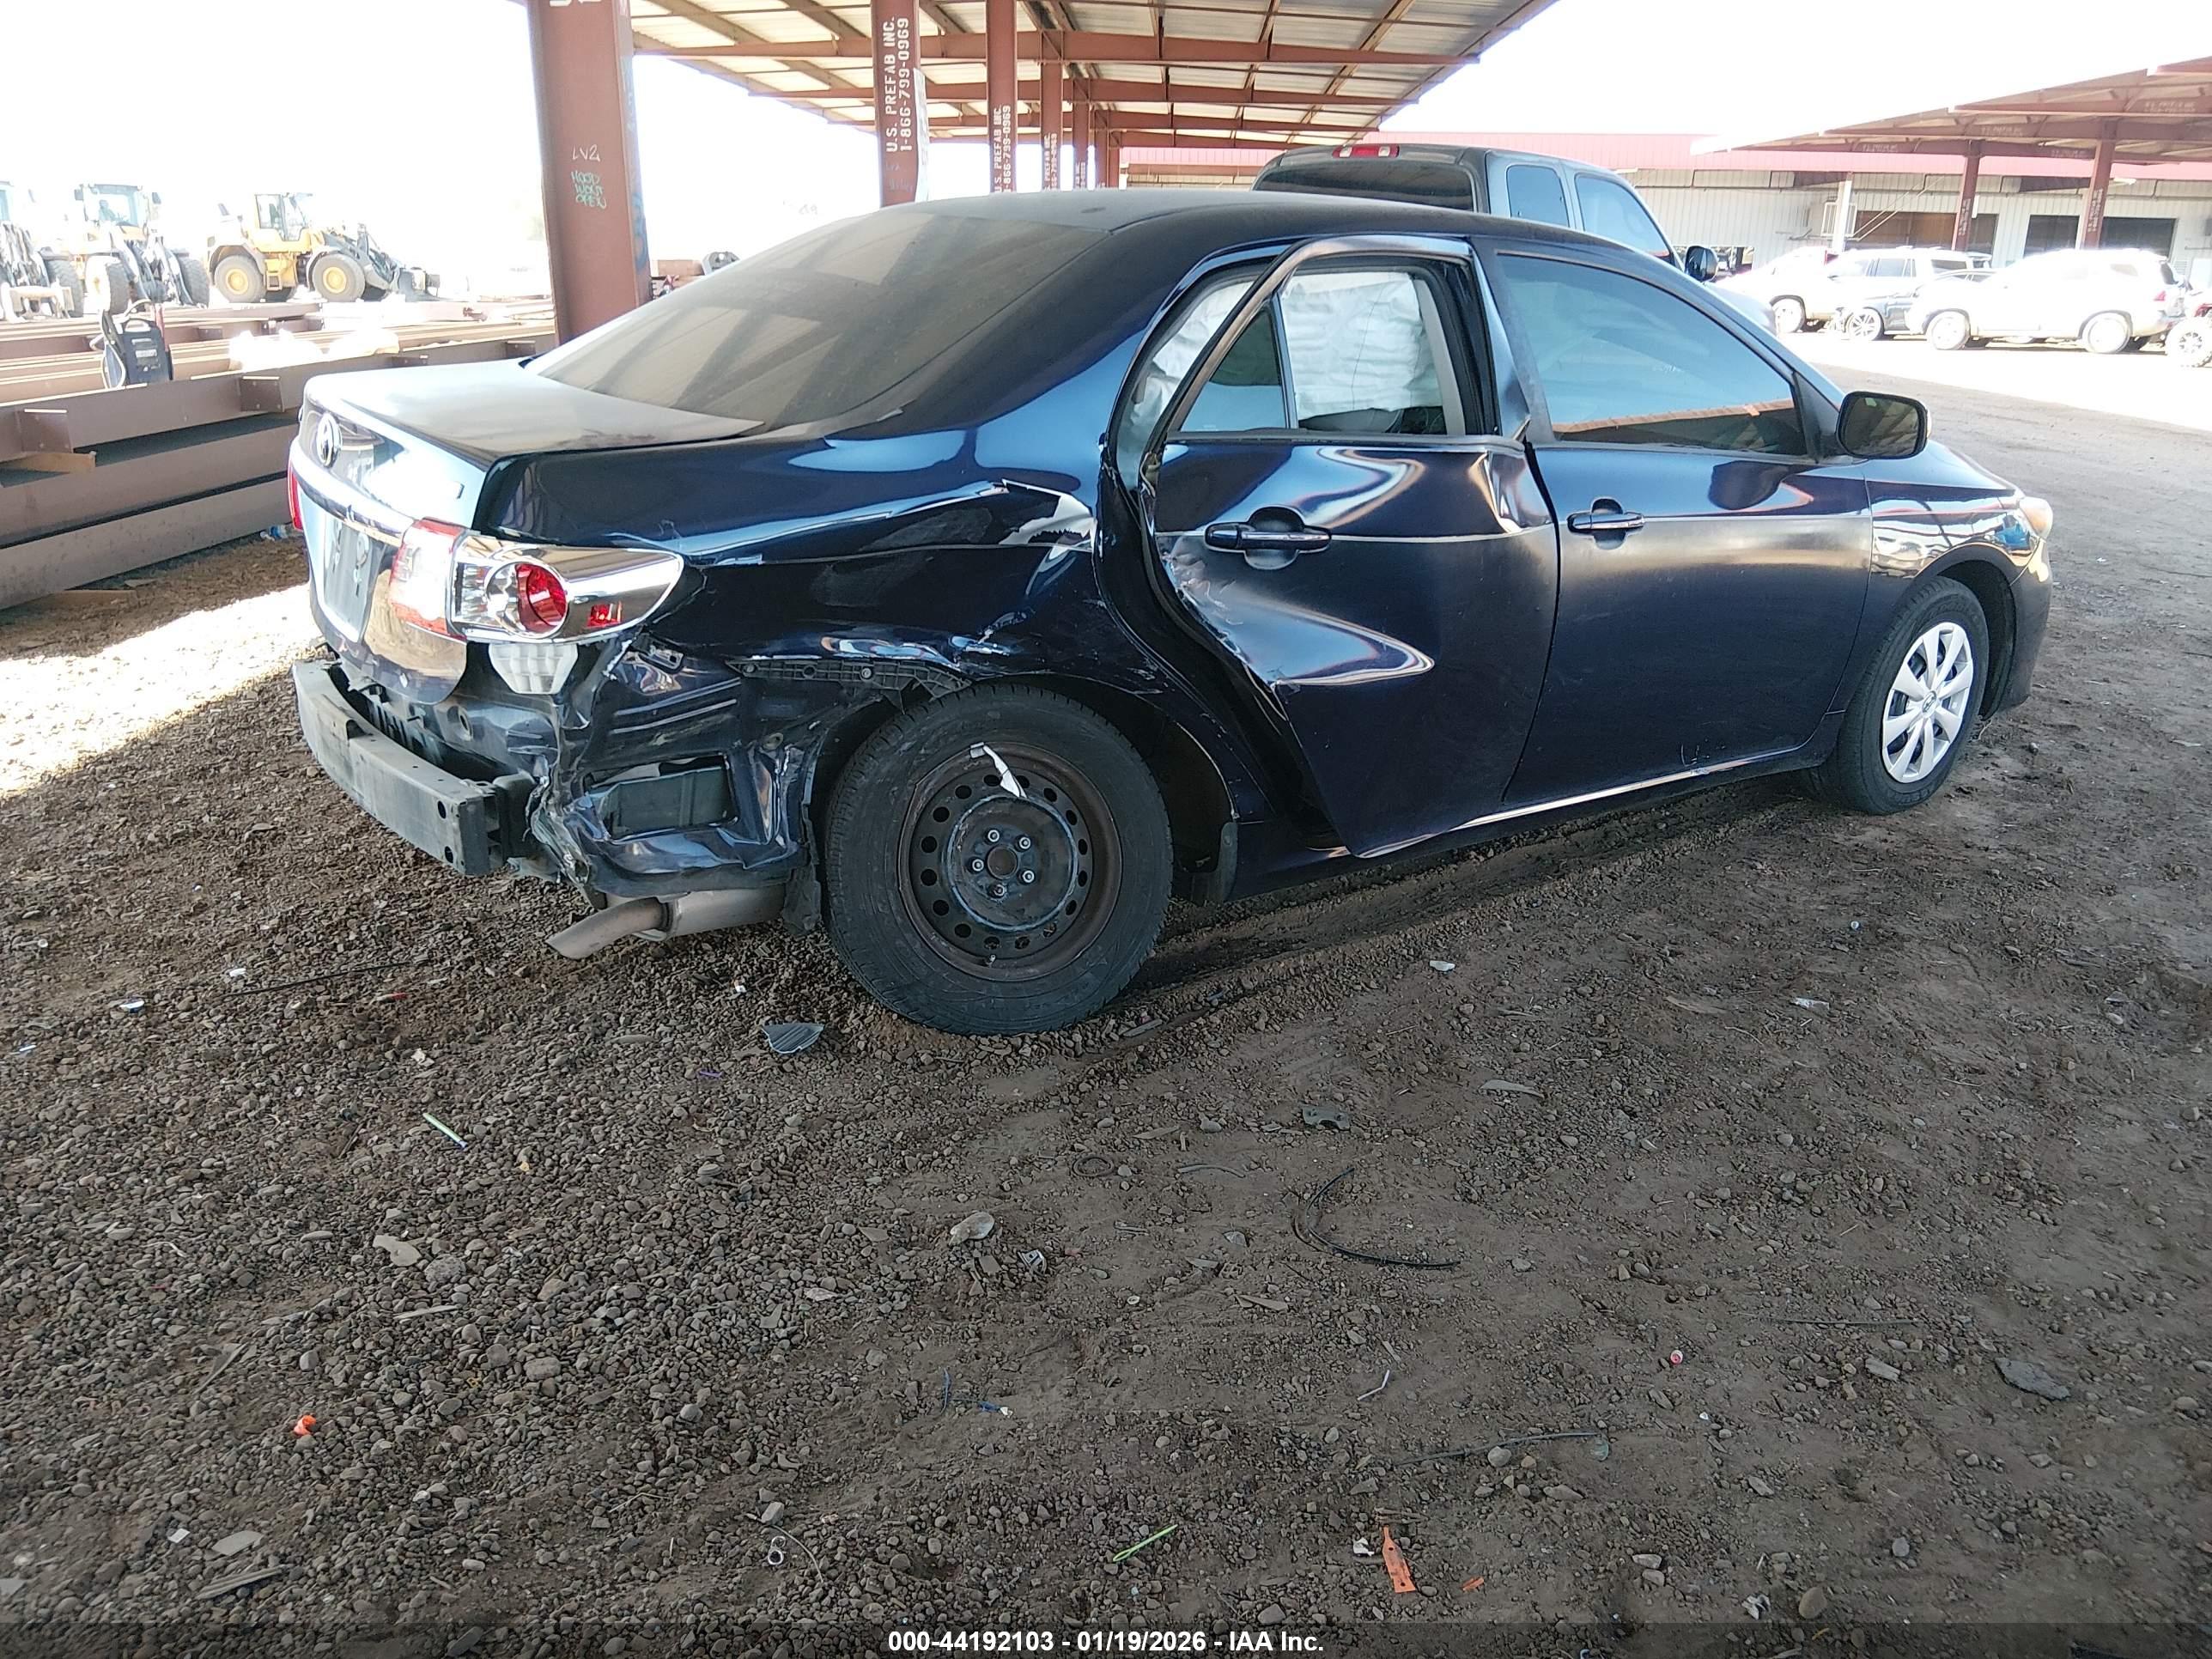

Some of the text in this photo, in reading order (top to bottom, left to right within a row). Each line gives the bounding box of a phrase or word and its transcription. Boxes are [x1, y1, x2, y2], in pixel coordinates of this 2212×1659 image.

[883, 15, 896, 47] INC.
[884, 54, 897, 115] PREFAB
[897, 18, 912, 152] 1-866-799-0969
[885, 123, 898, 153] U.S.
[994, 129, 1002, 169] PREFAB
